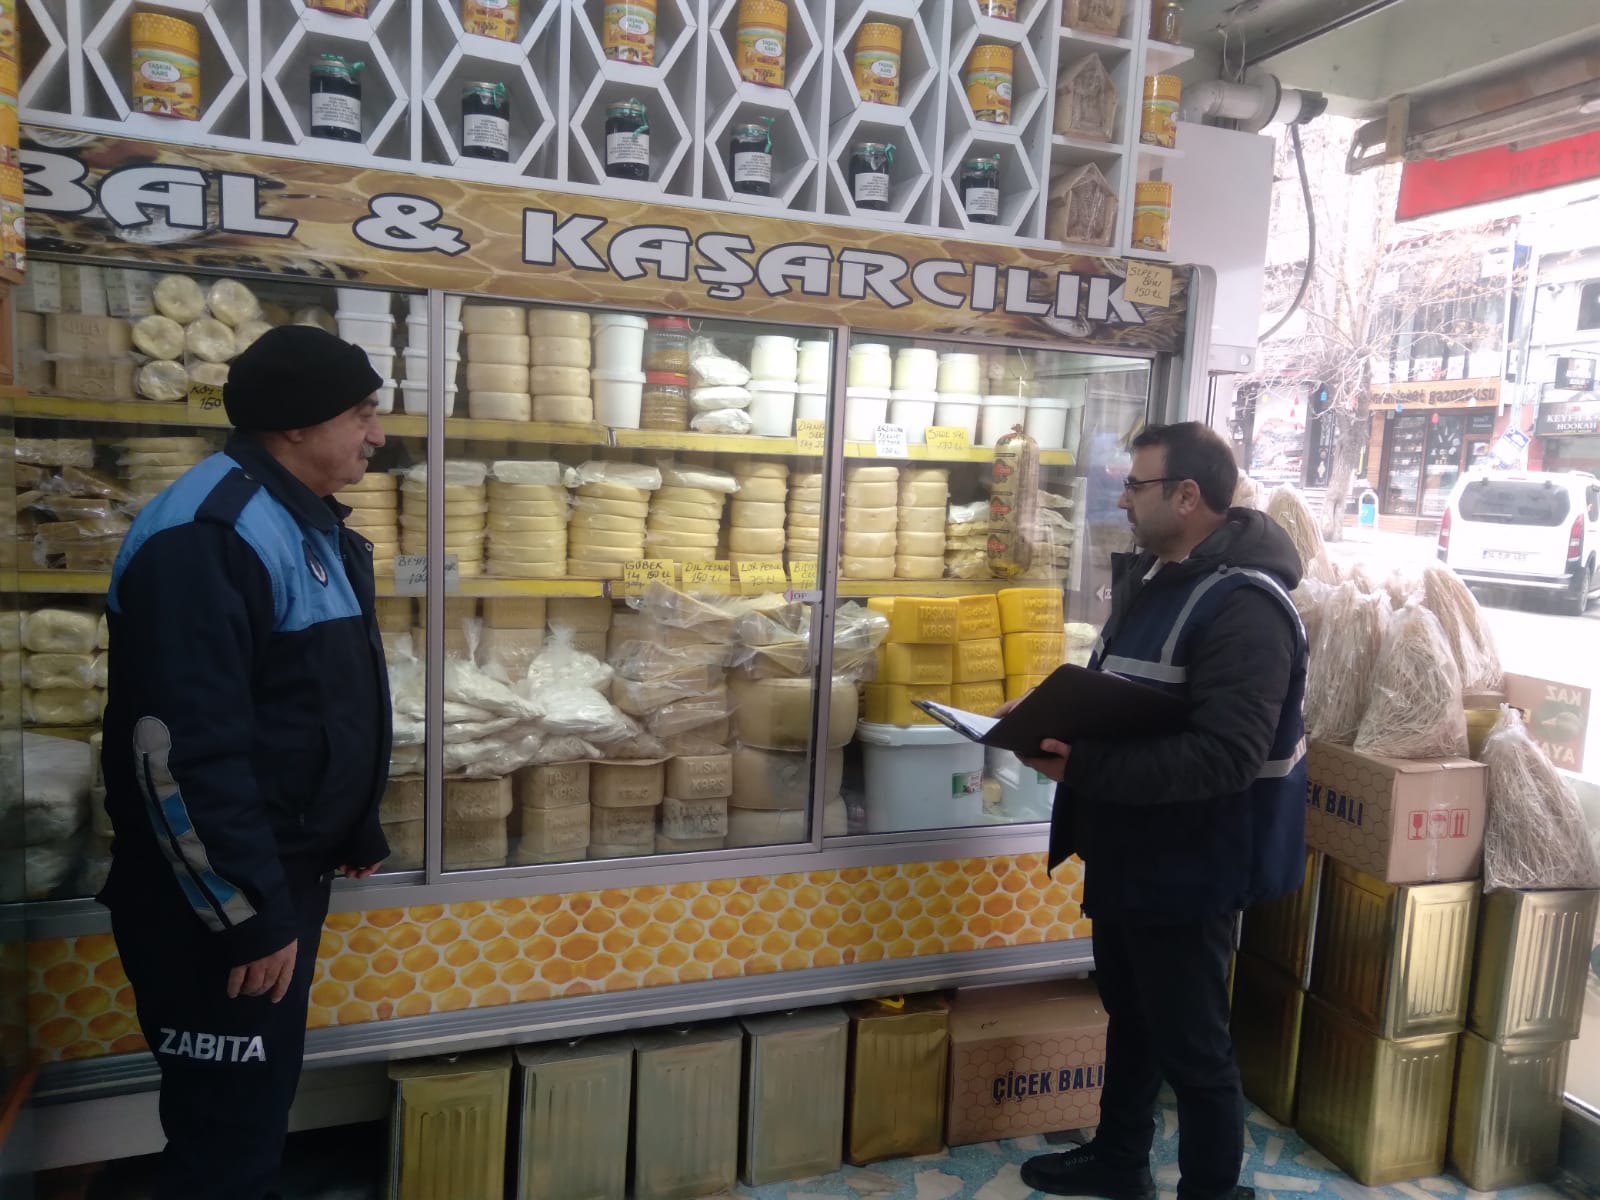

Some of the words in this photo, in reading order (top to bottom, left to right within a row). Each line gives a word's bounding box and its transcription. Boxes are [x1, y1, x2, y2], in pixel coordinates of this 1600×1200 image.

[353, 193, 471, 256] &
[521, 206, 1148, 325] KAŞARCILIK
[1326, 788, 1364, 826] BALI
[159, 1028, 267, 1062] ZABITA
[992, 1071, 1052, 1105] ÇİÇEK
[1058, 1065, 1104, 1092] BALI
